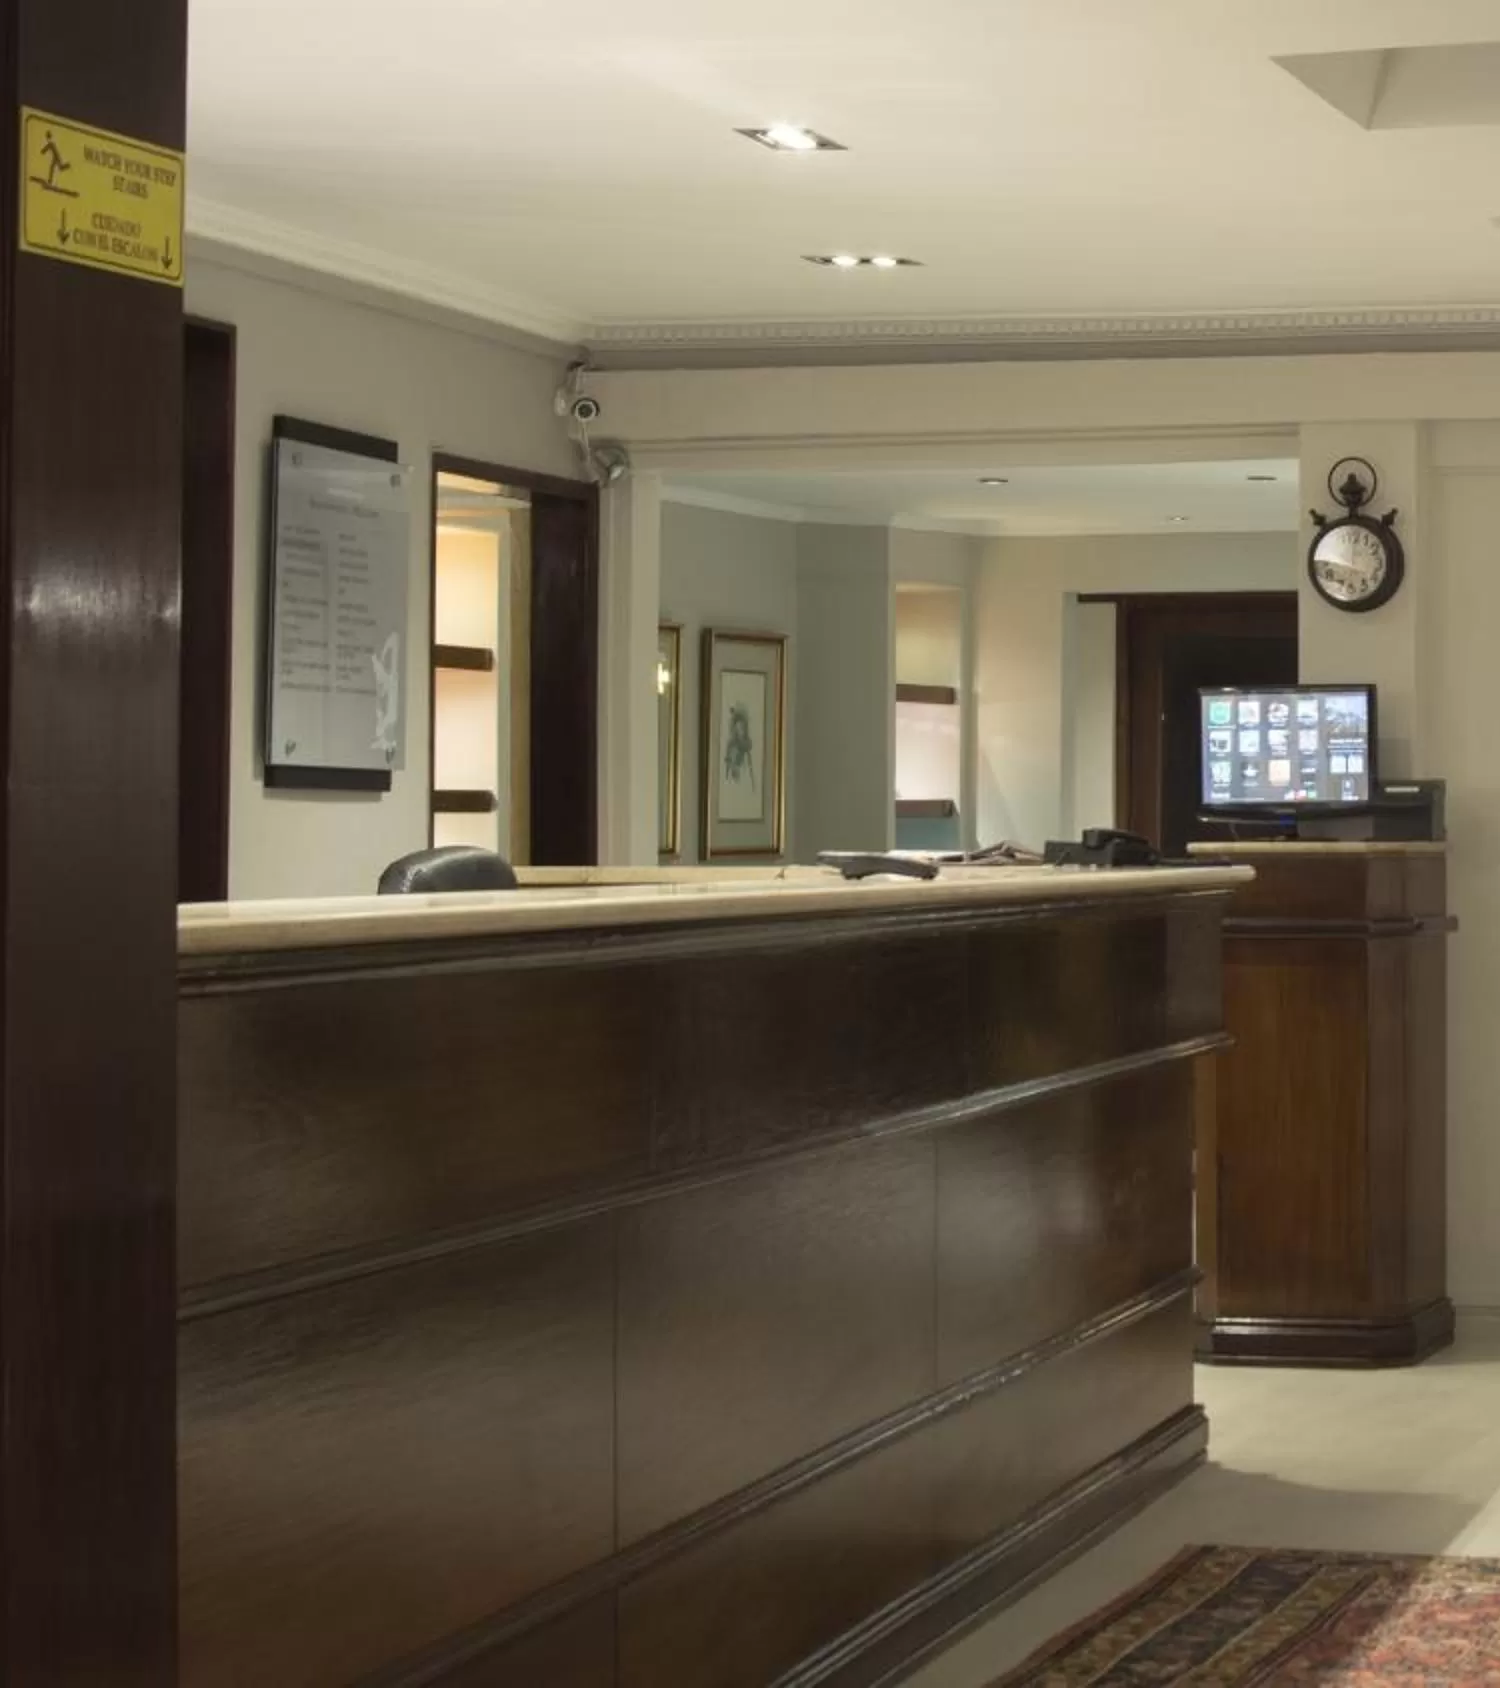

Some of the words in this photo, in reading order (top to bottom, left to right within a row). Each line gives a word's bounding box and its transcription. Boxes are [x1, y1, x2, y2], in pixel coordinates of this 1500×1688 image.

[83, 143, 122, 172] WATCH
[124, 158, 151, 179] YOUR
[154, 166, 176, 188] STEP
[112, 174, 149, 200] STAIRS
